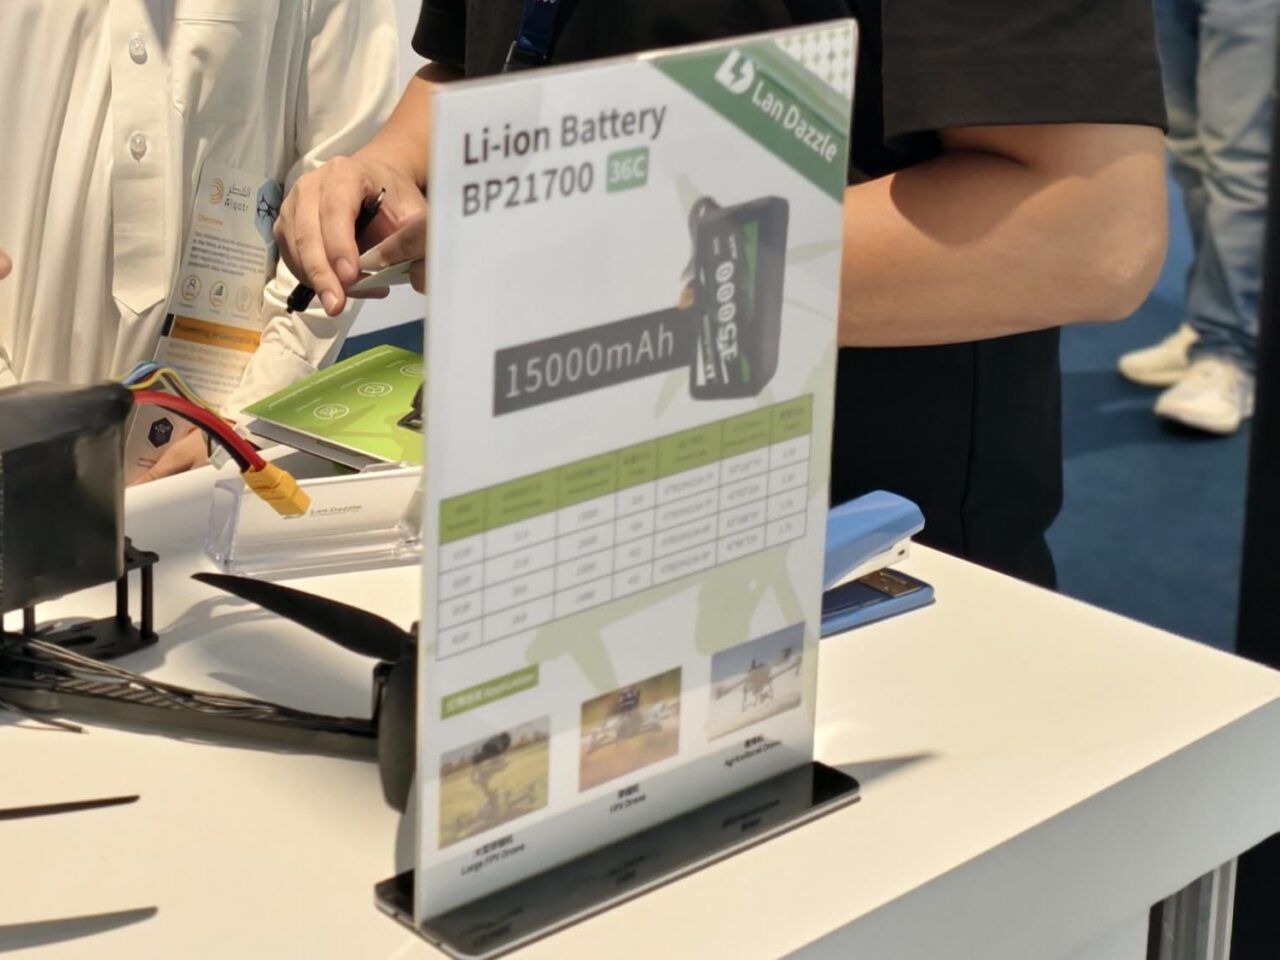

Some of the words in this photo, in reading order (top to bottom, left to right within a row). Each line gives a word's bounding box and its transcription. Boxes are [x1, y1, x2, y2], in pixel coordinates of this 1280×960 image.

[463, 123, 551, 166] Li-ion
[560, 105, 667, 144] Battery
[751, 80, 784, 121] Lan
[782, 106, 838, 163] Dazzle
[462, 162, 594, 217] BP21700
[608, 154, 646, 186] 36C
[506, 327, 675, 399] 15000mAh
